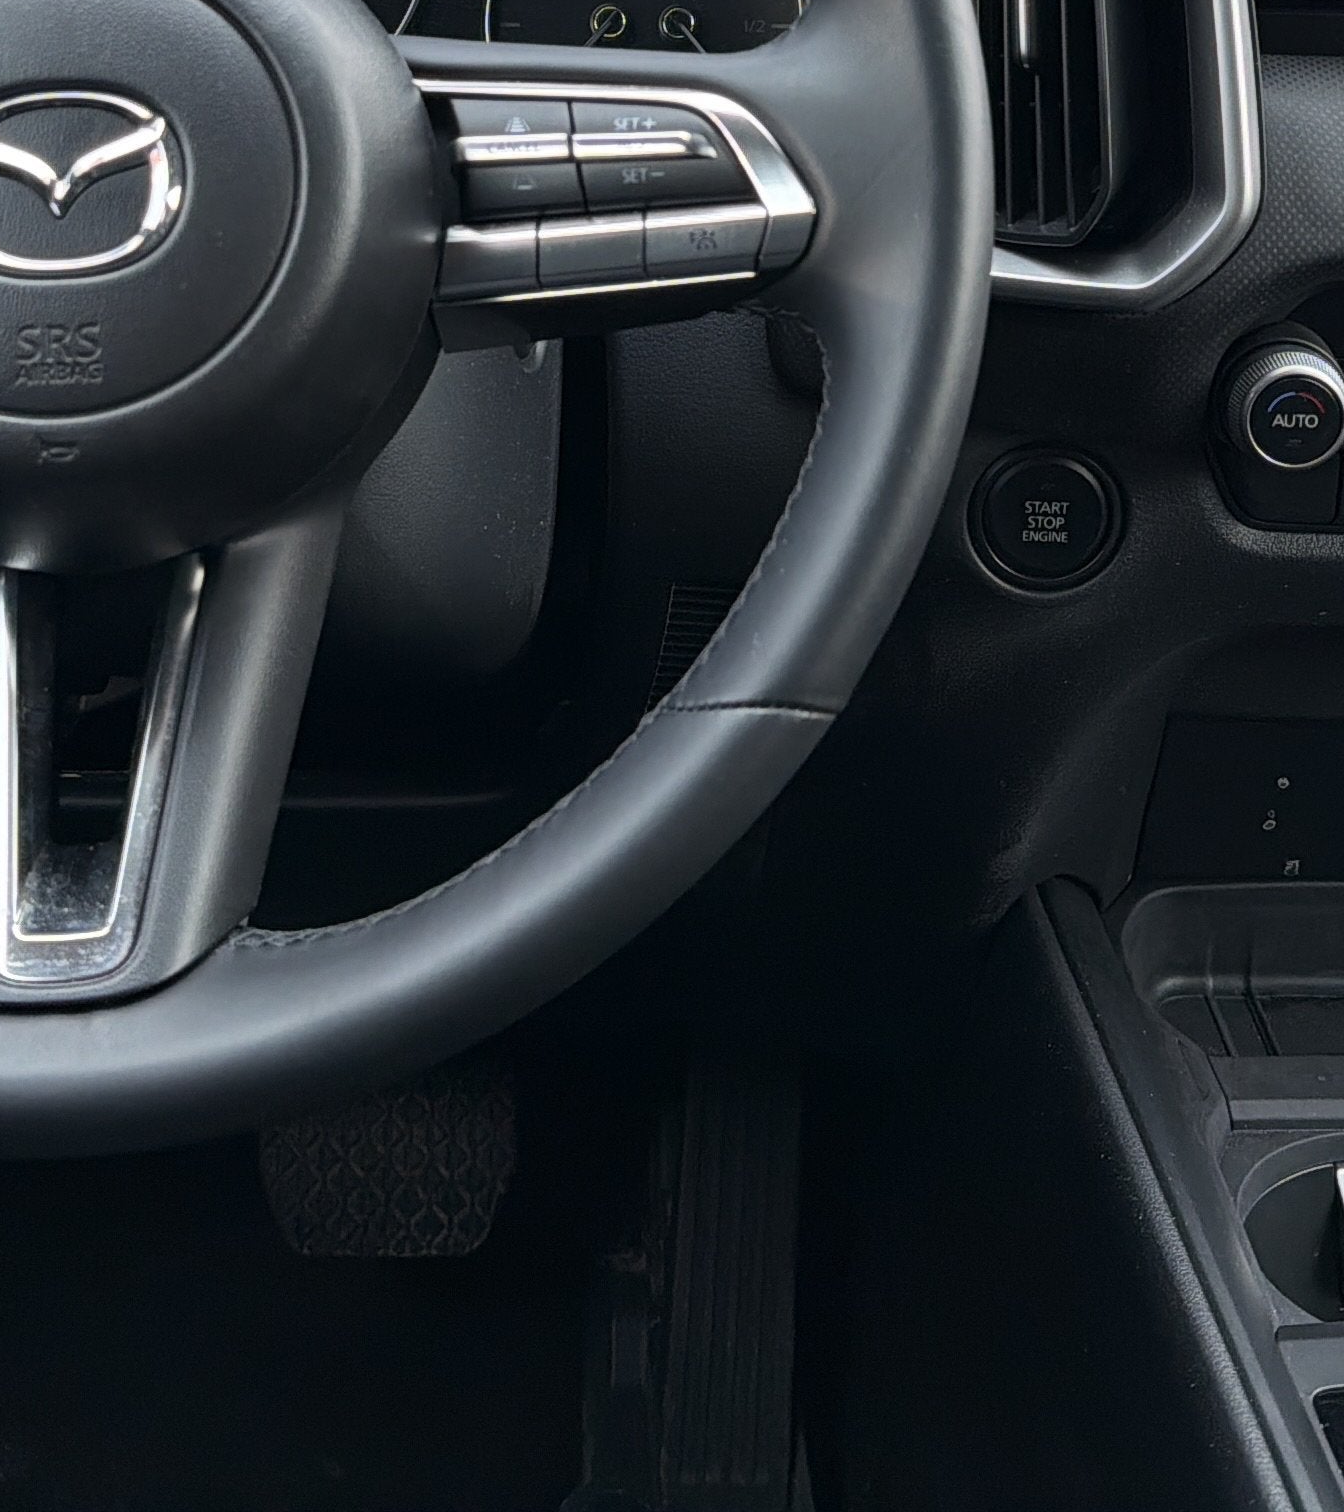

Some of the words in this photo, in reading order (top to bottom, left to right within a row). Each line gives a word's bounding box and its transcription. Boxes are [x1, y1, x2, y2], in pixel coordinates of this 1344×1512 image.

[743, 21, 765, 34] 1/2
[15, 322, 103, 363] SRS
[15, 362, 105, 386] AIRBAG
[1272, 413, 1320, 429] AUTO
[1024, 500, 1070, 516] START
[1027, 514, 1066, 530] STOP
[1022, 528, 1069, 544] ENGINE
